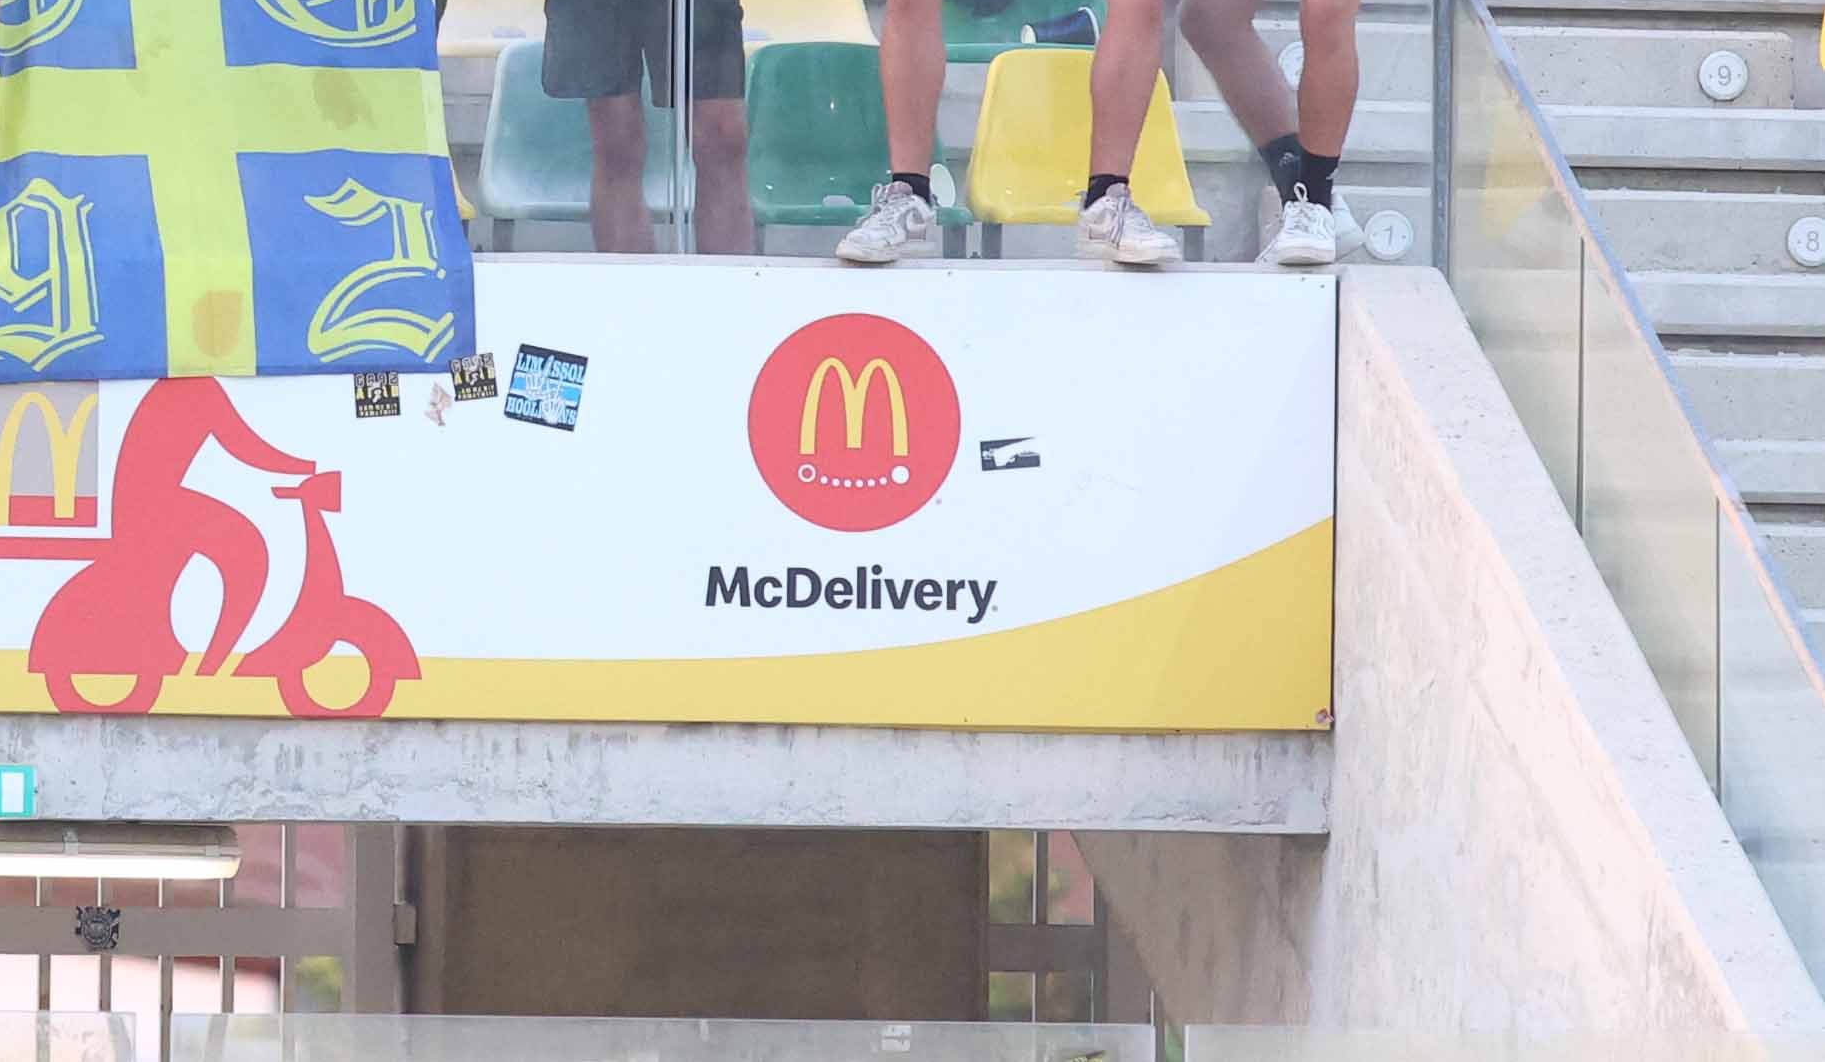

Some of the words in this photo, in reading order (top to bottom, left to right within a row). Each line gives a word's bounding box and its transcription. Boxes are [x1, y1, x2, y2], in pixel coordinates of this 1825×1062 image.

[1716, 64, 1732, 87] 9
[1805, 230, 1820, 252] 8
[705, 564, 997, 624] McDelivery
